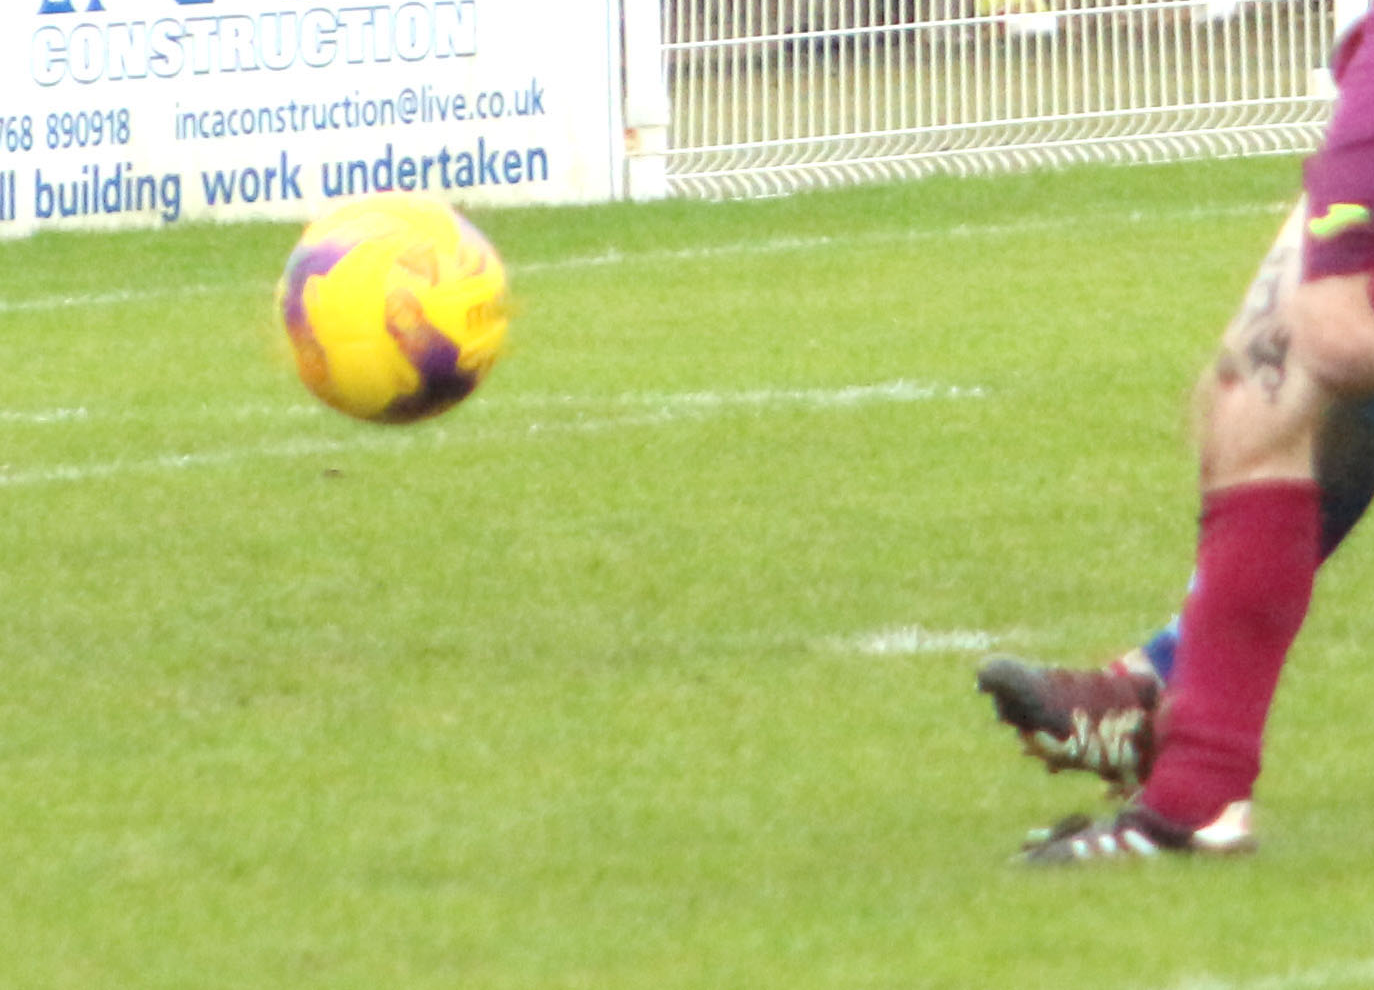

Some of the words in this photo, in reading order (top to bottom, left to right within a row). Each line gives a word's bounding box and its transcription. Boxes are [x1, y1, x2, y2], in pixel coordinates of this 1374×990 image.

[31, 0, 477, 87] CONSTRUCTION
[46, 107, 131, 150] 890918
[175, 78, 545, 140] incaconstruction@live.co.uk
[34, 161, 182, 223] building
[202, 151, 303, 206] work
[321, 137, 550, 197] undertaken
